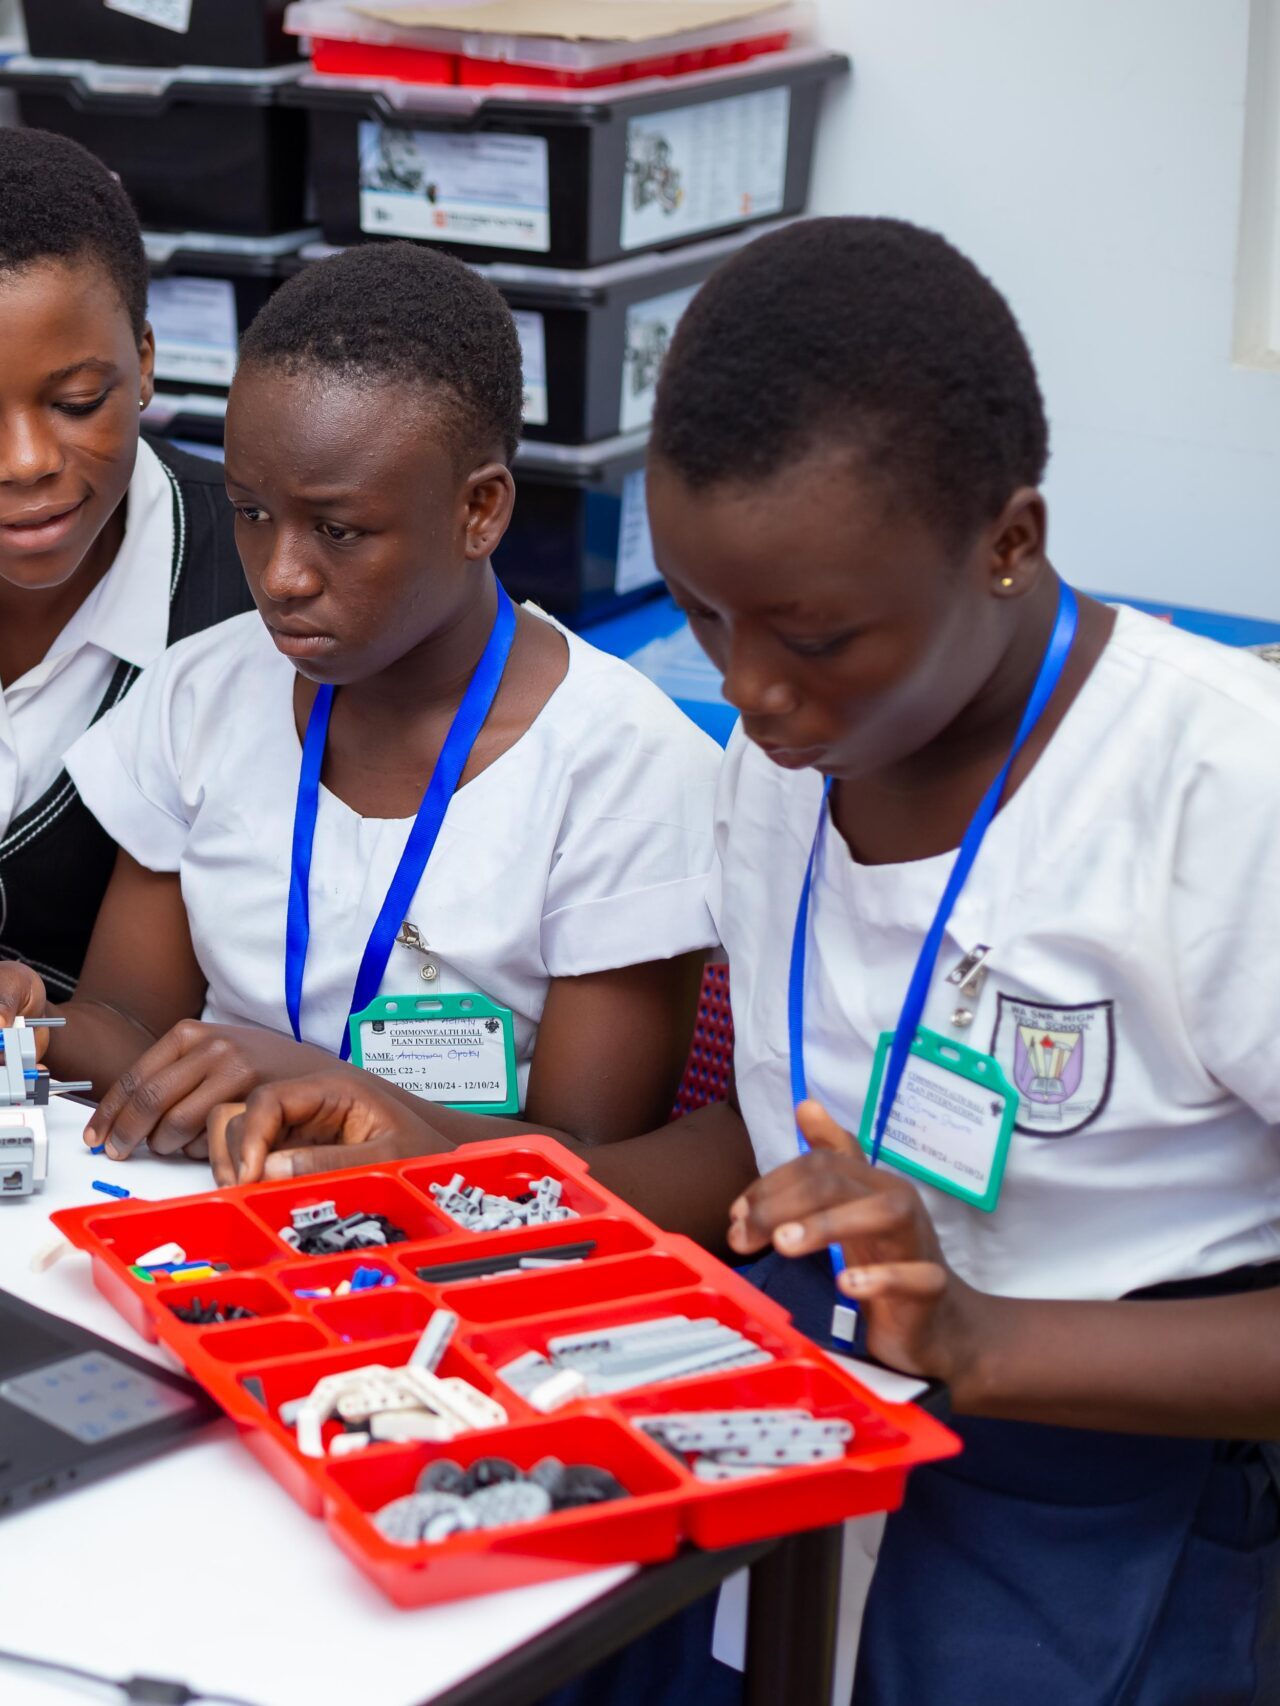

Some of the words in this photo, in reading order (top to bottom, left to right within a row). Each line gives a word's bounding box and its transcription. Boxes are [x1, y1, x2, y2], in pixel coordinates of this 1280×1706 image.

[461, 1028, 483, 1036] HALL
[415, 1037, 484, 1045] INTERNATIONAL
[365, 1052, 394, 1060] NAME:
[396, 1082, 423, 1091] TION:
[425, 1081, 456, 1090] 8/10/24
[464, 1081, 500, 1090] 12/10/24
